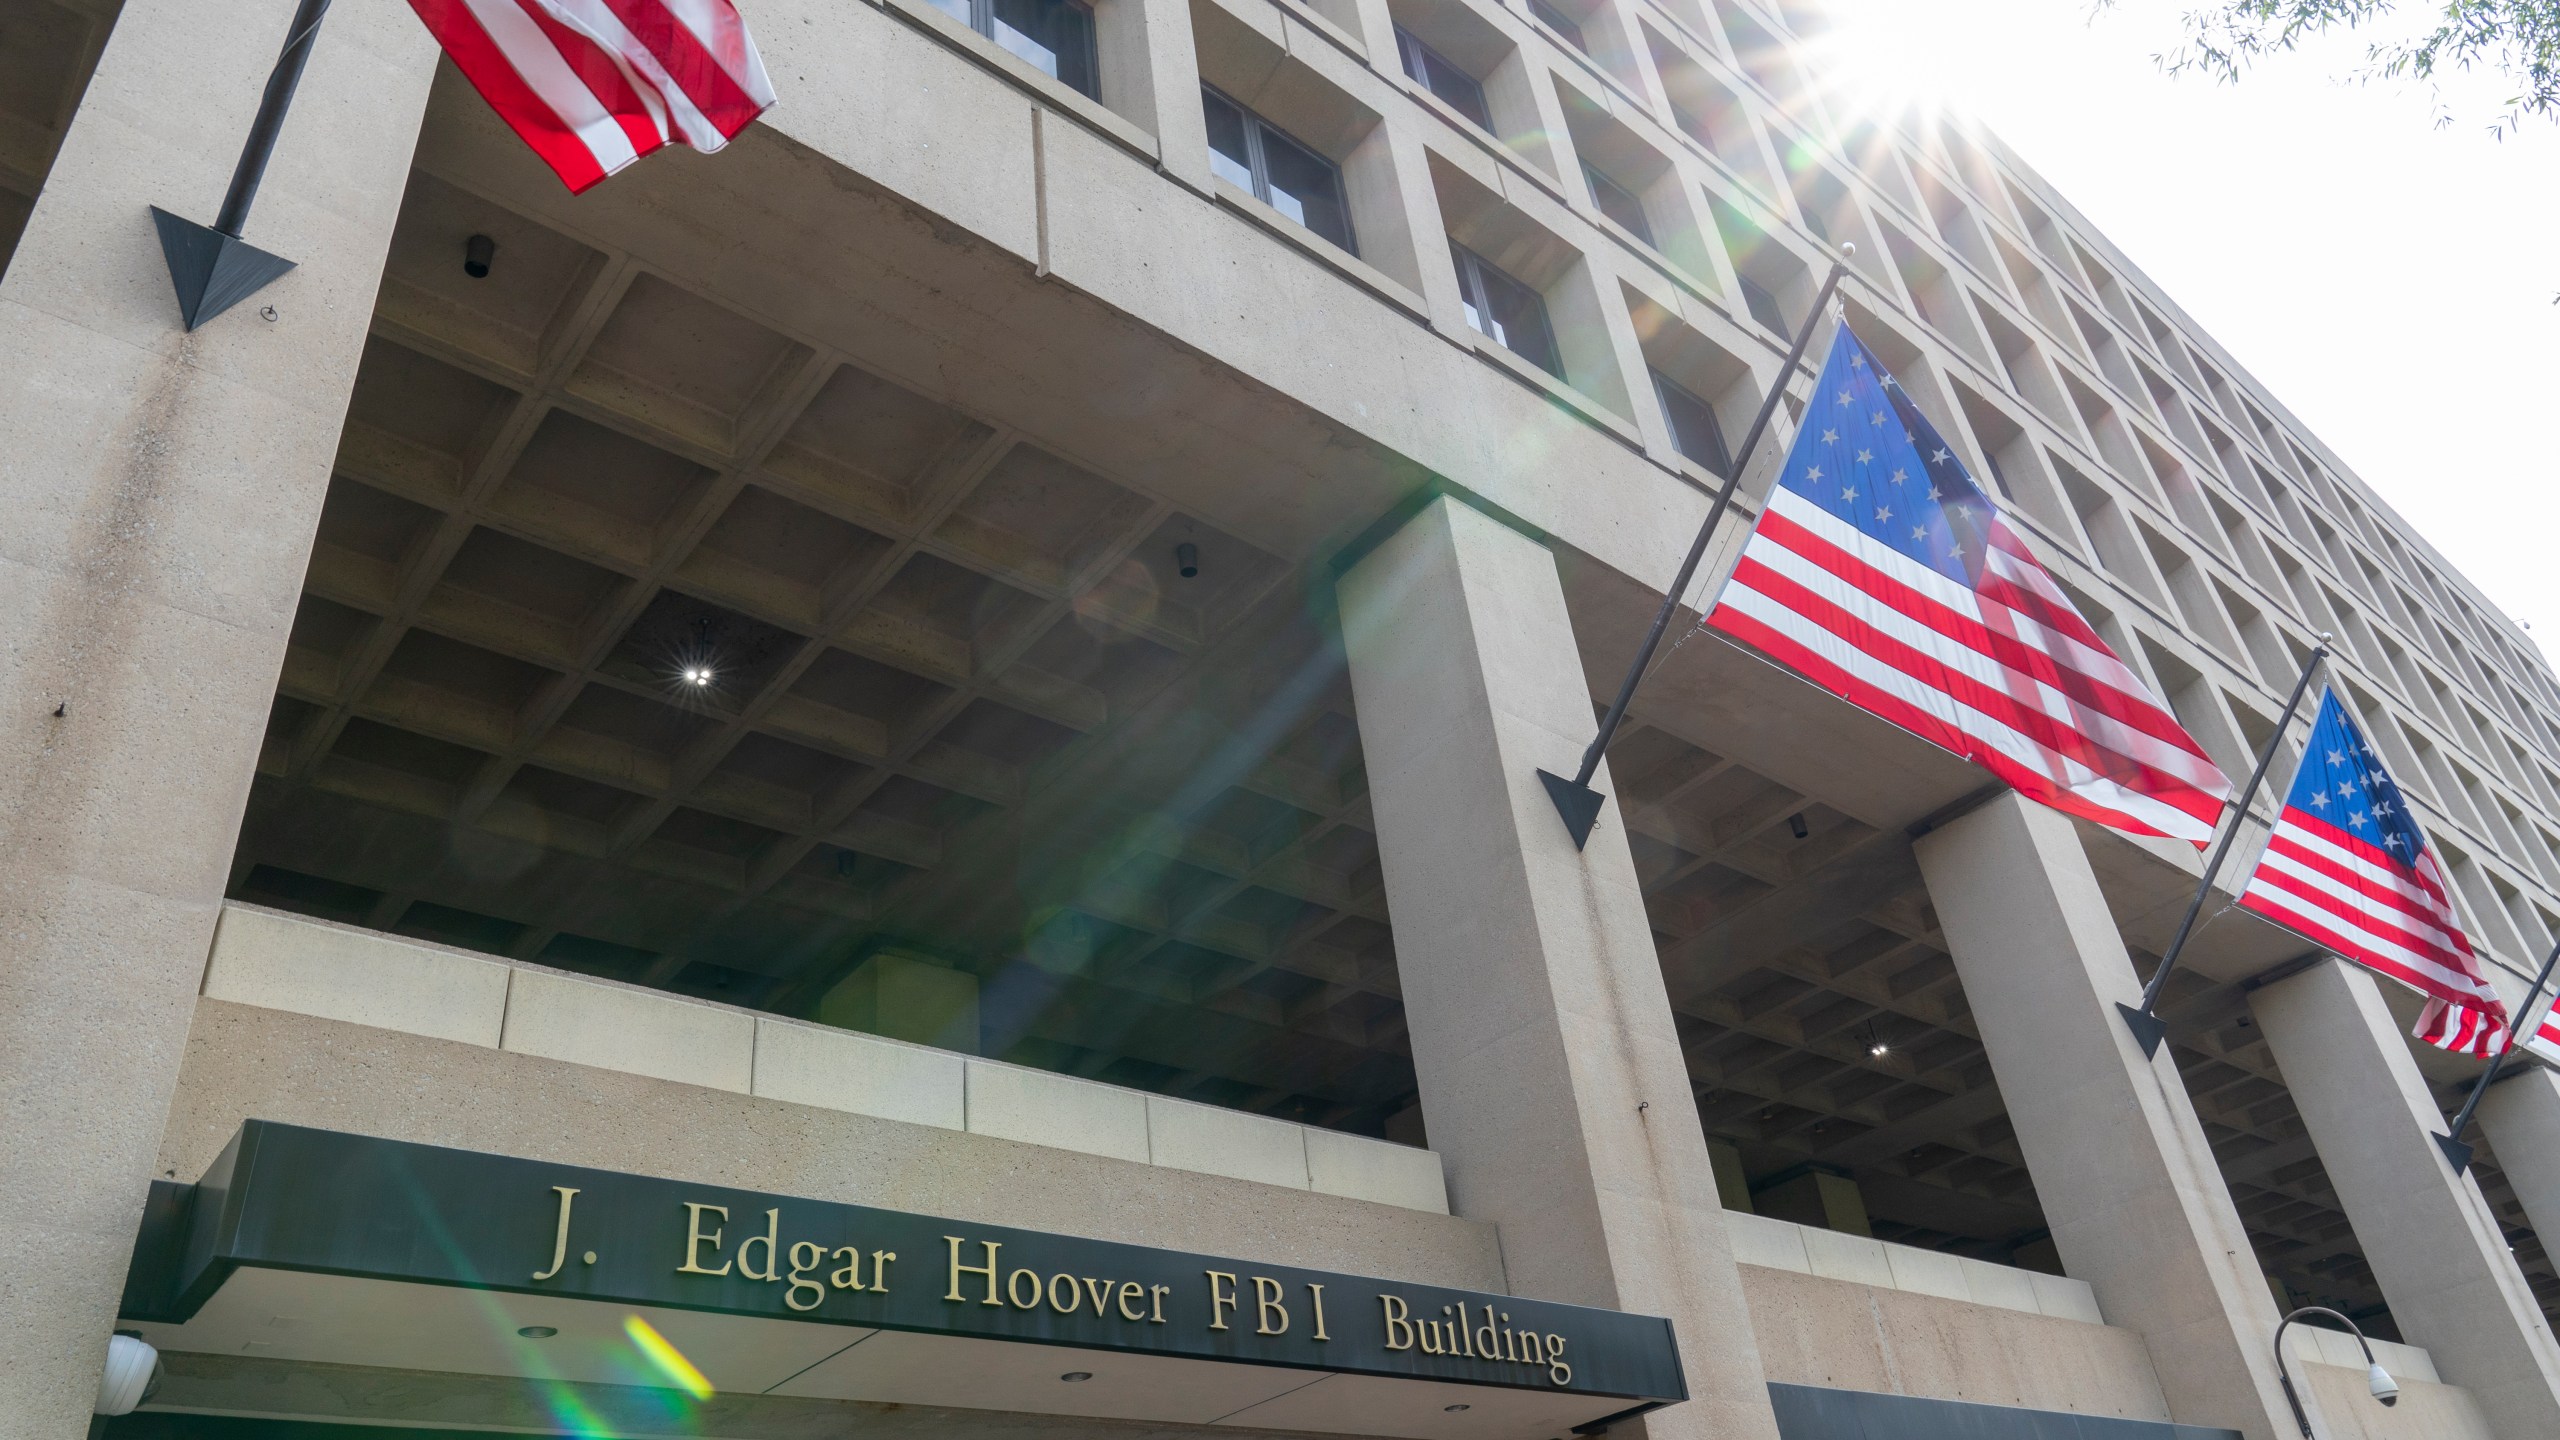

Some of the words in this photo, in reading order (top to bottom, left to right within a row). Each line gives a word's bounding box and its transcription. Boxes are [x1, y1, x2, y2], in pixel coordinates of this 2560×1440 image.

[532, 1185, 598, 1281] J.
[676, 1202, 896, 1311] Edgar
[943, 1235, 1170, 1324] Hoover
[1205, 1269, 1331, 1341] FBI
[1379, 1294, 1572, 1386] Building
